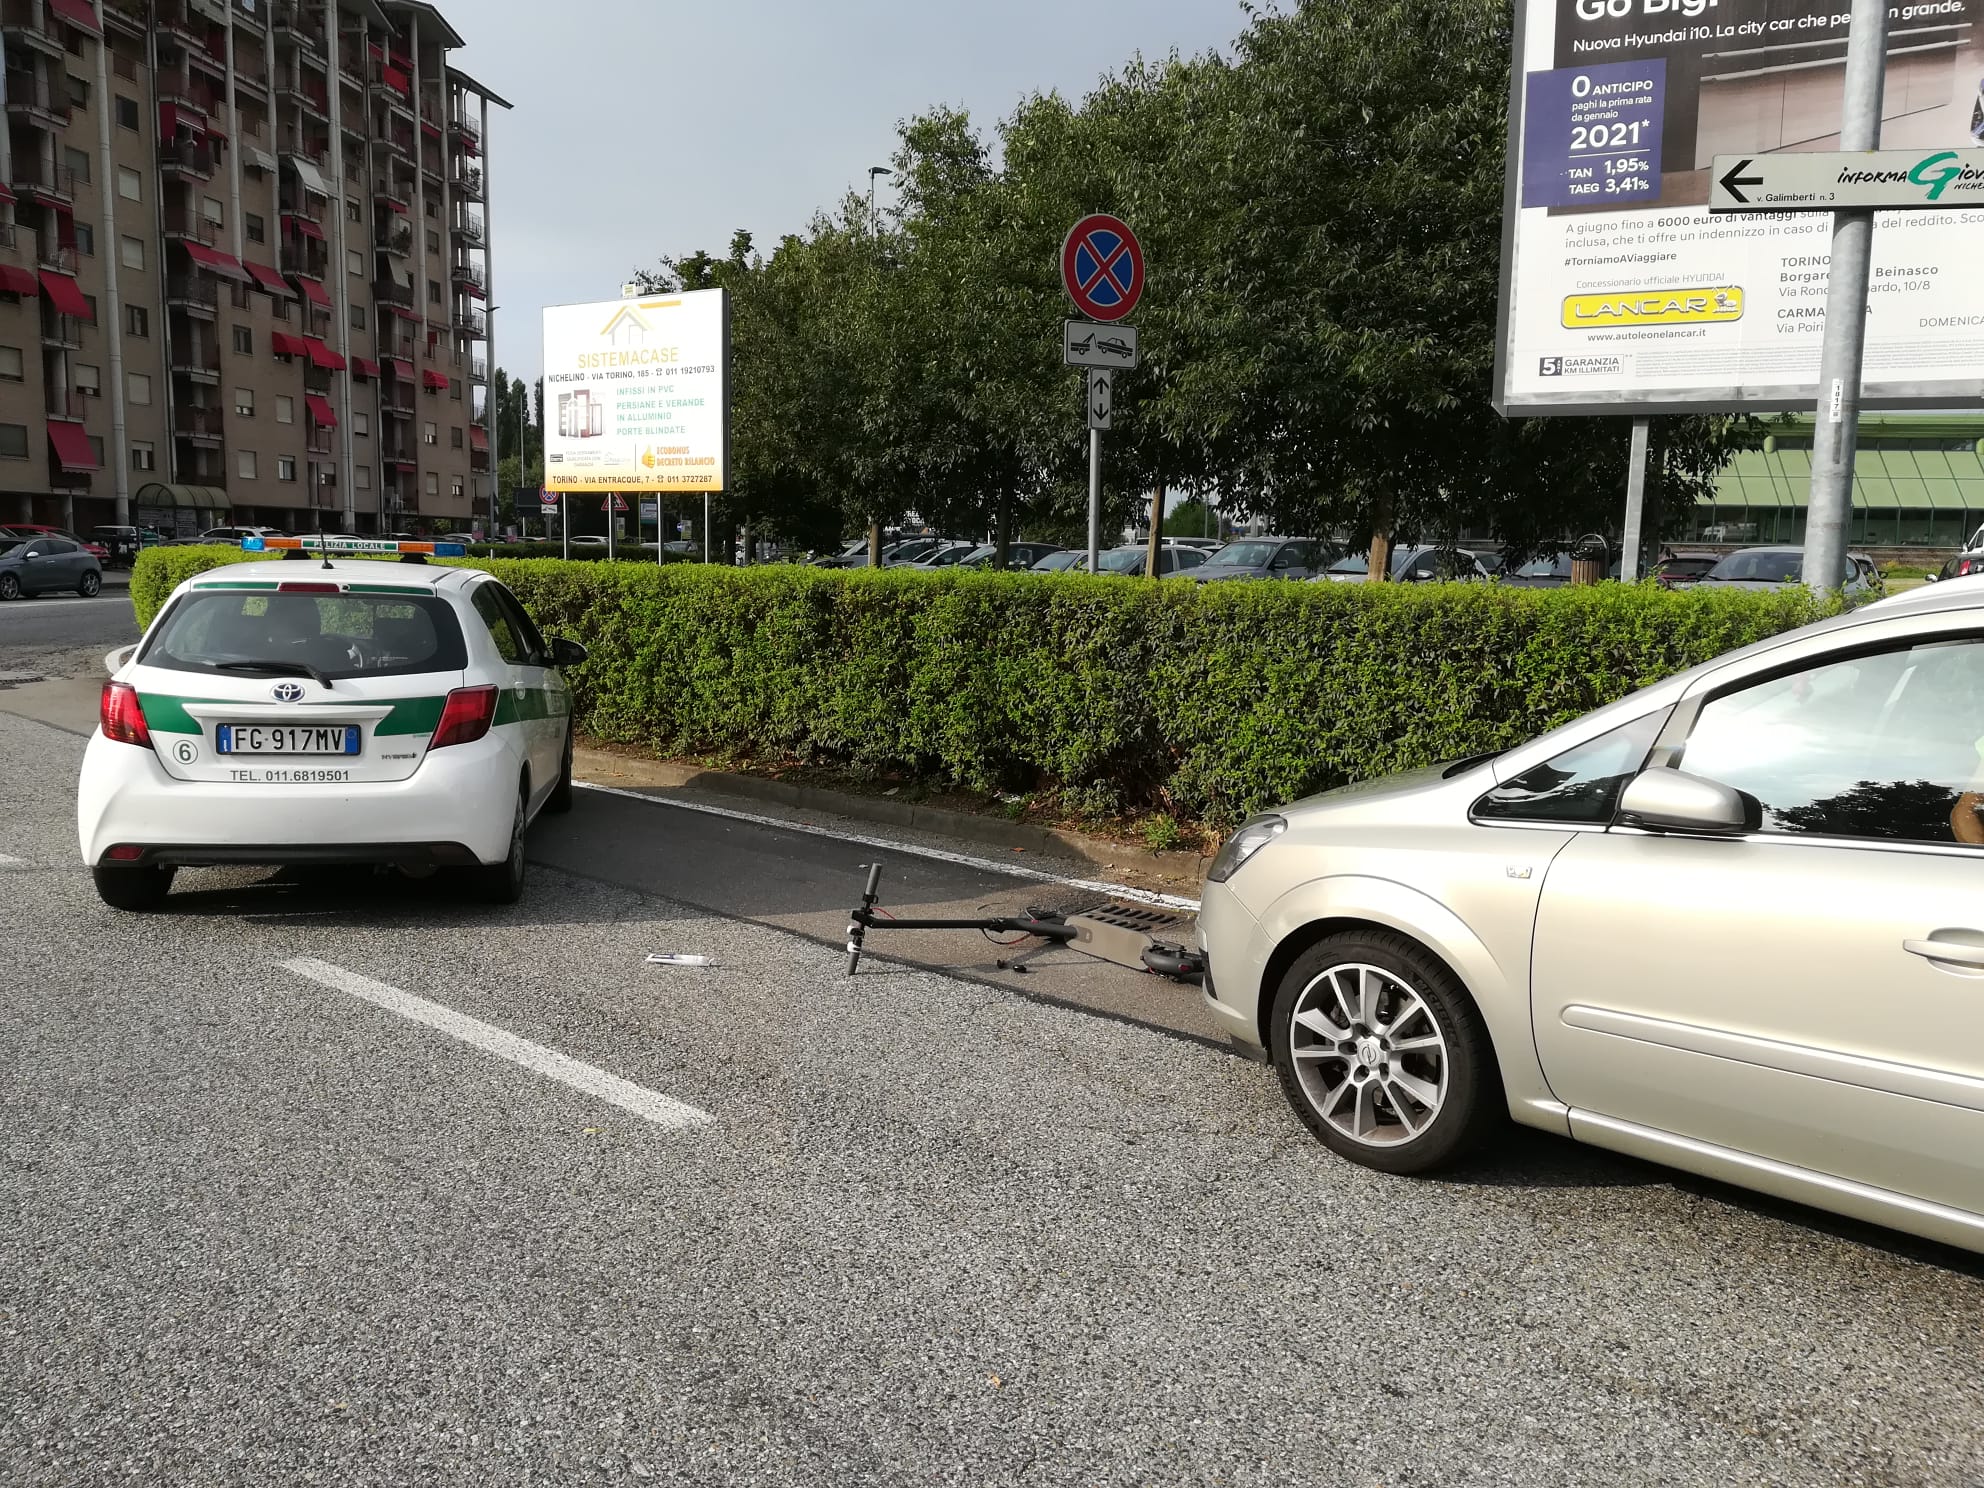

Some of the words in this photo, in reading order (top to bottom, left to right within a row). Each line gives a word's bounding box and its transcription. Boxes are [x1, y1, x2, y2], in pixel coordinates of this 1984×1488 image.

[1576, 0, 1632, 20] Go
[1902, 0, 1966, 20] grande.
[1573, 38, 1621, 52] Nuova
[1624, 28, 1687, 48] Hyundai
[1690, 26, 1713, 40] i10.
[1716, 25, 1734, 37] La
[1738, 21, 1766, 36] city
[1769, 18, 1795, 30] car
[1798, 14, 1827, 28] che
[1572, 75, 1590, 97] 0
[1592, 80, 1653, 96] ANTICIPO
[1572, 101, 1597, 112] paghi
[1599, 99, 1607, 108] la
[1608, 98, 1634, 110] prima
[1636, 95, 1652, 104] rata
[1572, 113, 1582, 122] da
[1584, 110, 1618, 122] gennaio
[1569, 168, 1592, 179] TAN
[1604, 158, 1650, 176] 1,95%
[1569, 182, 1600, 194] TAEG
[1605, 176, 1650, 194] 3,41%
[1766, 192, 1816, 202] Galimberti
[1566, 224, 1574, 234] A
[1577, 221, 1618, 235] giugno
[1622, 219, 1644, 230] fino
[1647, 220, 1654, 228] a
[1658, 216, 1690, 228] 6000
[1694, 216, 1722, 225] euro
[1726, 213, 1737, 222] di
[1740, 212, 1797, 222] vantaggi
[1882, 218, 1902, 228] del
[1906, 215, 1957, 228] reddito.
[1960, 213, 1984, 224] Sco
[1565, 236, 1610, 249] inclusa,
[1612, 235, 1634, 246] che
[1638, 234, 1646, 244] ti
[1648, 232, 1677, 243] offre
[1680, 232, 1695, 241] un
[1699, 227, 1765, 240] indennizzo
[1769, 226, 1780, 236] in
[1784, 225, 1813, 234] caso
[1817, 222, 1828, 232] di
[1564, 252, 1677, 267] #TorniamoAViaggiare
[1781, 256, 1831, 267] TORINO
[1876, 266, 1938, 277] Beinasco
[1576, 276, 1641, 288] Concessionario
[1644, 274, 1680, 286] ufficiale
[1682, 272, 1725, 283] HYUNDAI
[1904, 280, 1930, 291] 10/8
[1779, 287, 1797, 296] Via
[1576, 298, 1708, 318] LANCAR
[1776, 324, 1794, 333] Via
[1798, 322, 1824, 332] Poiri
[1588, 329, 1706, 342] www.autoleonelancar.it
[578, 347, 679, 368] SISTEMACASE
[1565, 358, 1619, 366] GARANZIA
[1542, 358, 1556, 374] 5
[548, 370, 585, 382] NICHELINO
[591, 370, 604, 380] VIA
[606, 369, 635, 380] TORINO,
[666, 368, 678, 376] 011
[616, 387, 644, 396] INFISSI
[658, 385, 674, 393] PVC
[616, 400, 656, 410] PERSIANE
[666, 398, 705, 408] VERANDE
[616, 414, 625, 422] IN
[627, 412, 672, 421] ALLUMINIO
[616, 426, 643, 436] PORTE
[645, 426, 686, 435] BLINDATE
[553, 476, 578, 484] TORINO
[599, 476, 644, 484] ENTRACQUE,
[352, 542, 386, 550] LOCALE
[180, 744, 192, 761] 6
[230, 770, 261, 782] TEL.
[266, 770, 350, 782] 011.6819501
